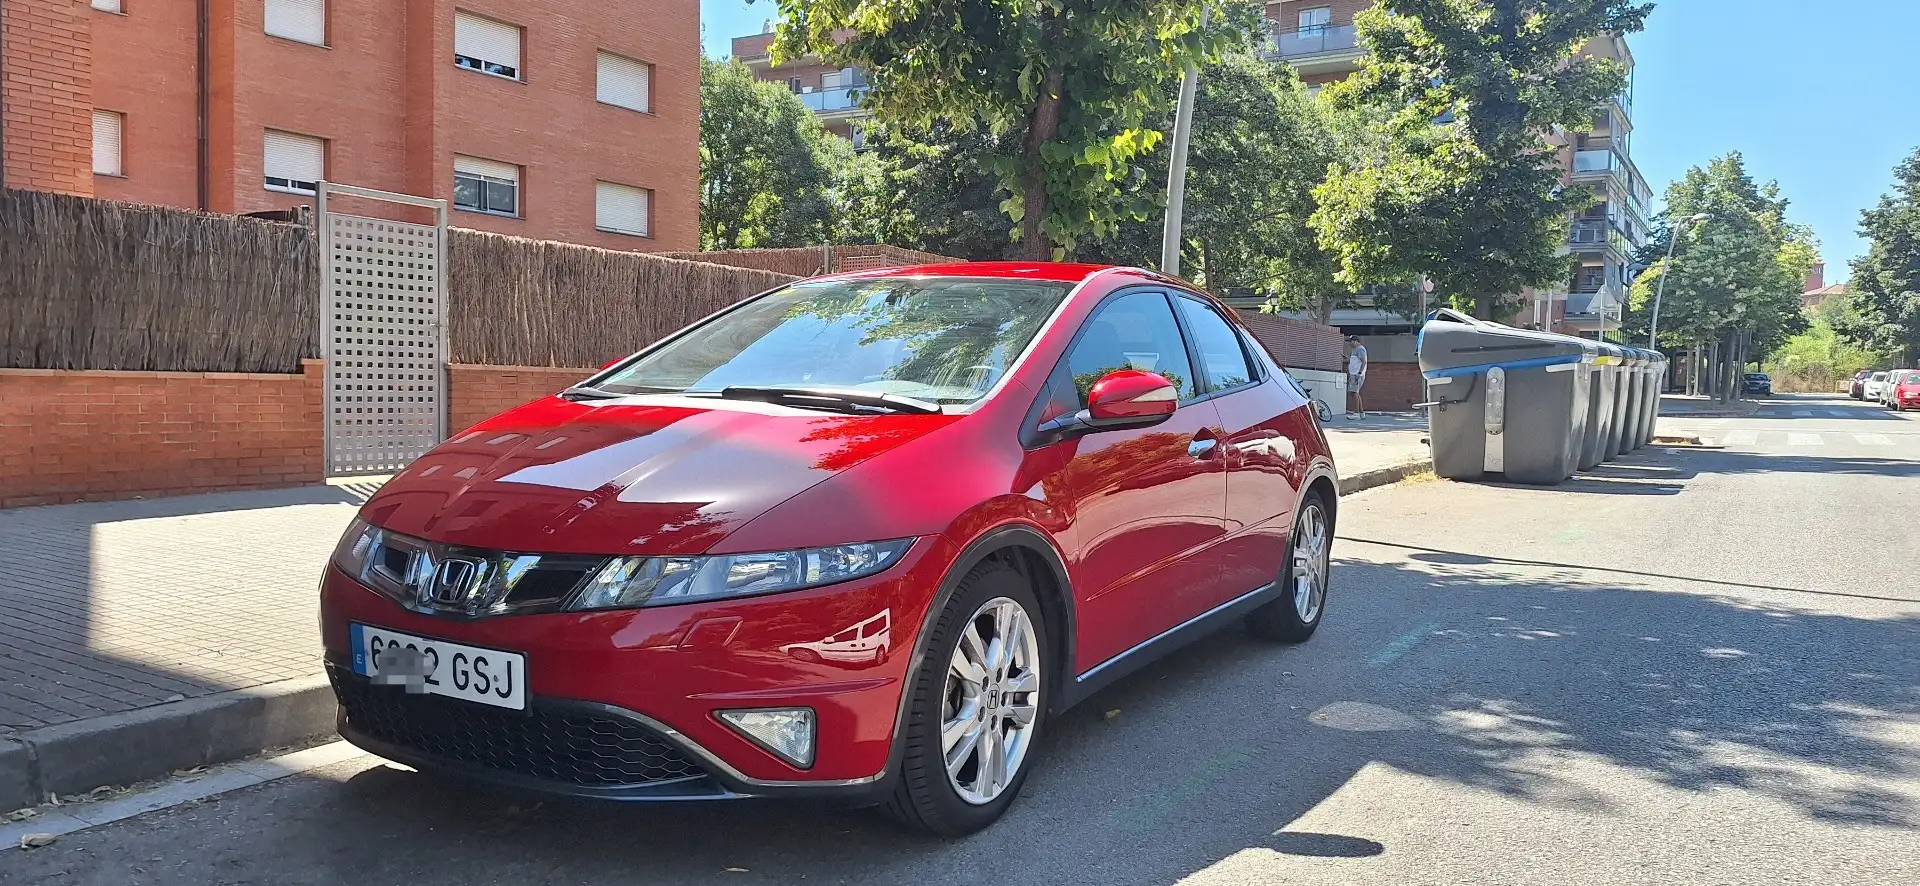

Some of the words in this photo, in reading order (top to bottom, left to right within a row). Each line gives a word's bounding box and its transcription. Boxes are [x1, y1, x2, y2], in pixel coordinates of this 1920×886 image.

[356, 653, 363, 665] E
[370, 635, 440, 686] 62
[452, 652, 513, 699] GSJ
